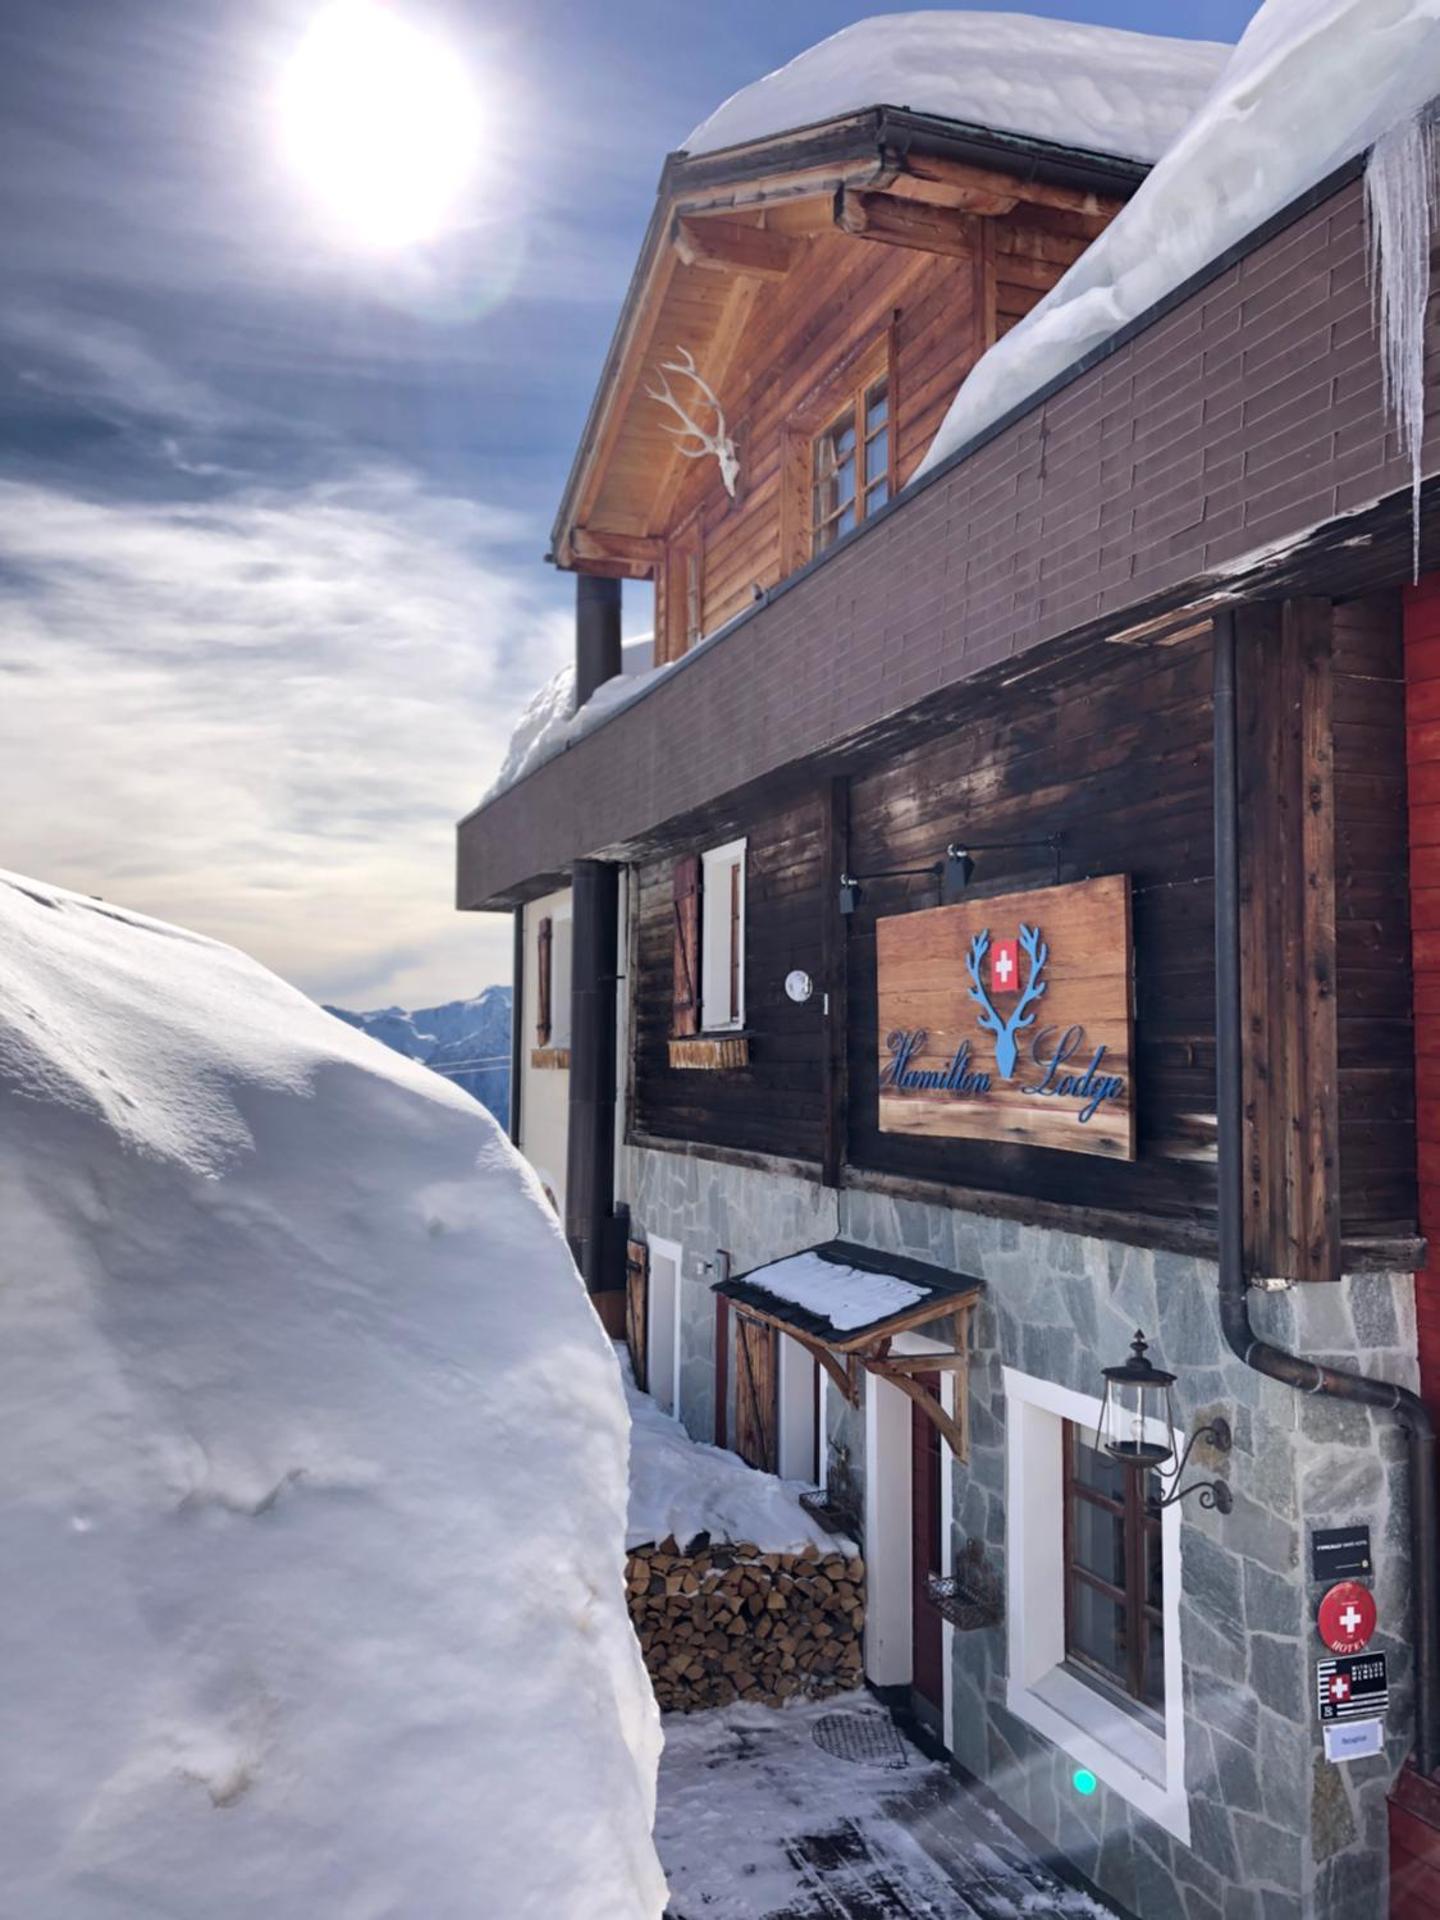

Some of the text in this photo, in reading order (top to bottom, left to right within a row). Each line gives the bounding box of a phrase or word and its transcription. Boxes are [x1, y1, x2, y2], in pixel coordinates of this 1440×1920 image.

[881, 1024, 1126, 1124] Hamilton Lodge
[1332, 1639, 1365, 1653] HOTEL
